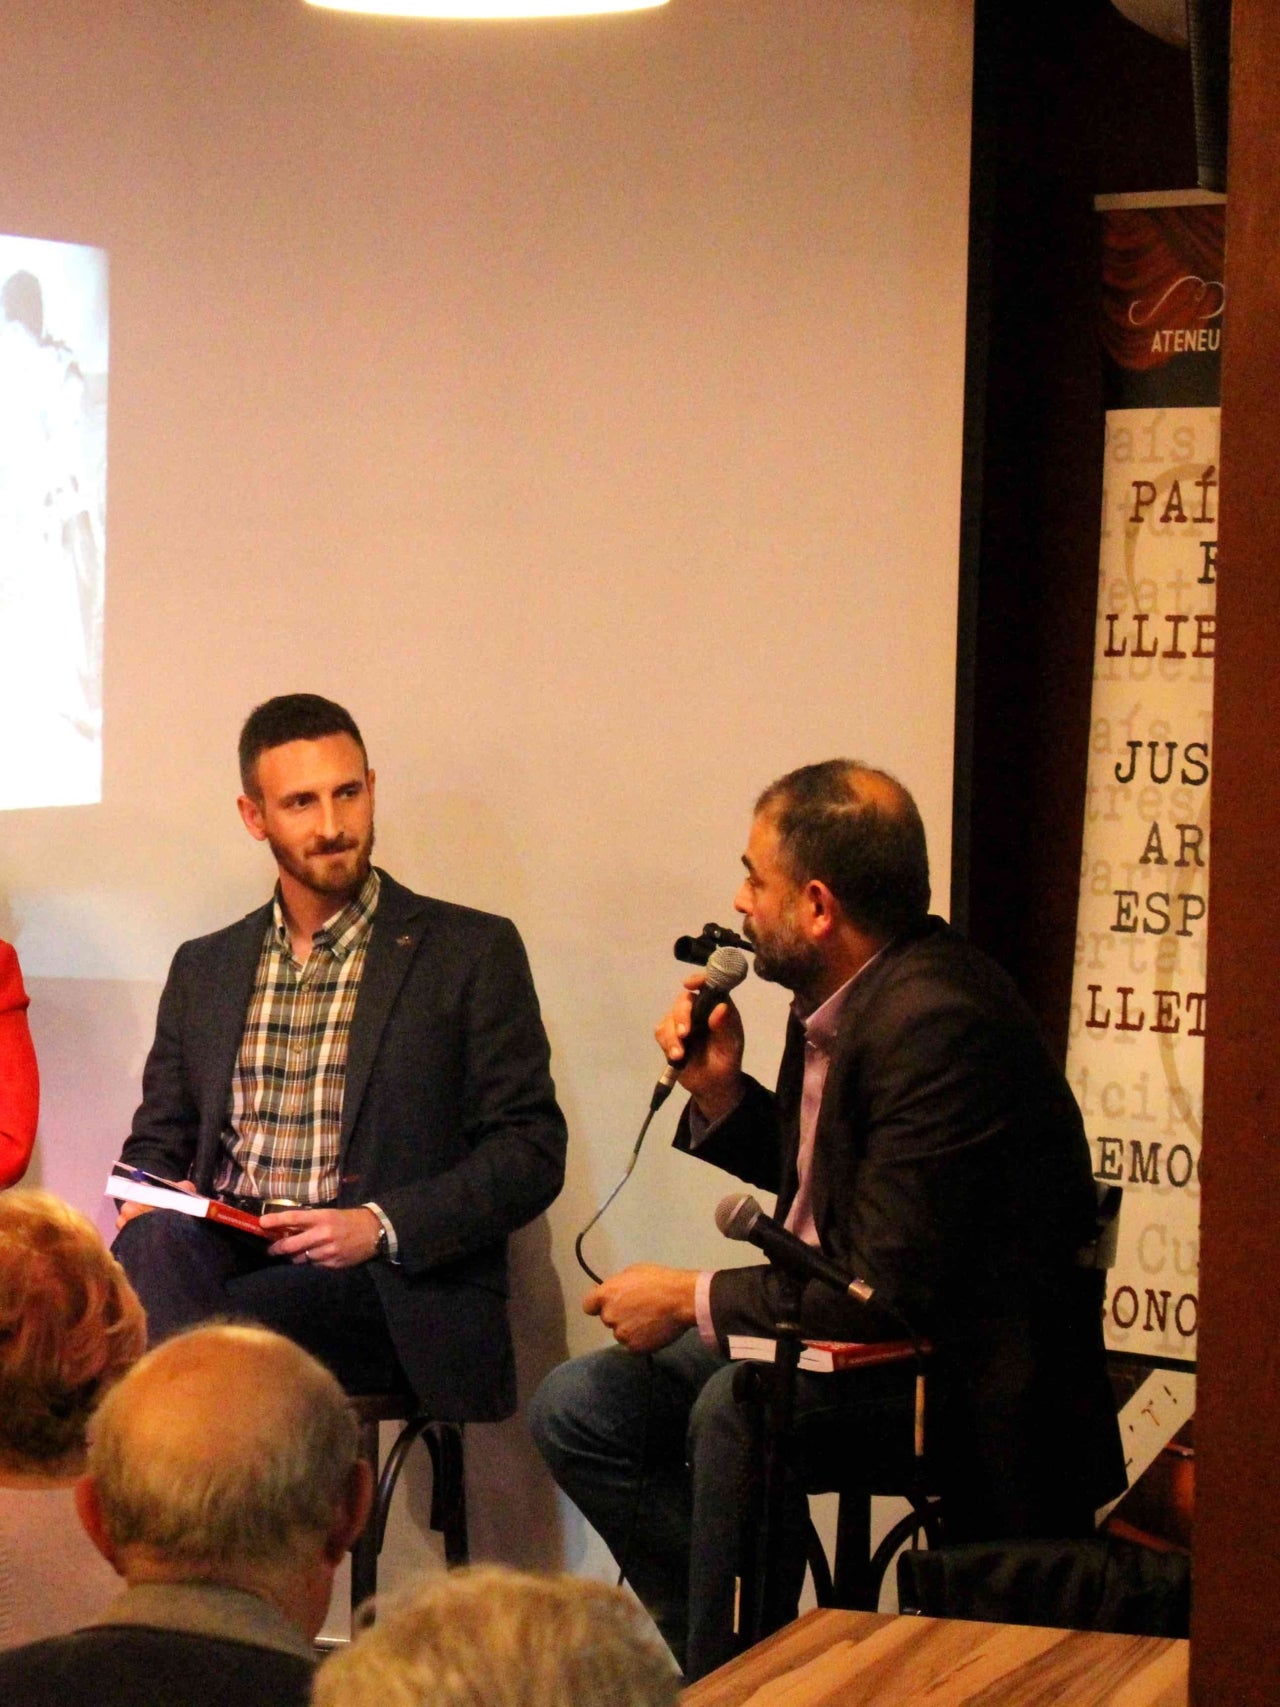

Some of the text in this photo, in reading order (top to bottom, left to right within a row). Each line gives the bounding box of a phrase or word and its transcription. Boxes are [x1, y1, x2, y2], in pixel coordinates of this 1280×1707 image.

[1151, 328, 1220, 353] ATENEU
[1115, 740, 1209, 786] JUS
[1139, 821, 1205, 867] AR
[1110, 890, 1206, 937] ESP
[1093, 1136, 1201, 1188] EMO
